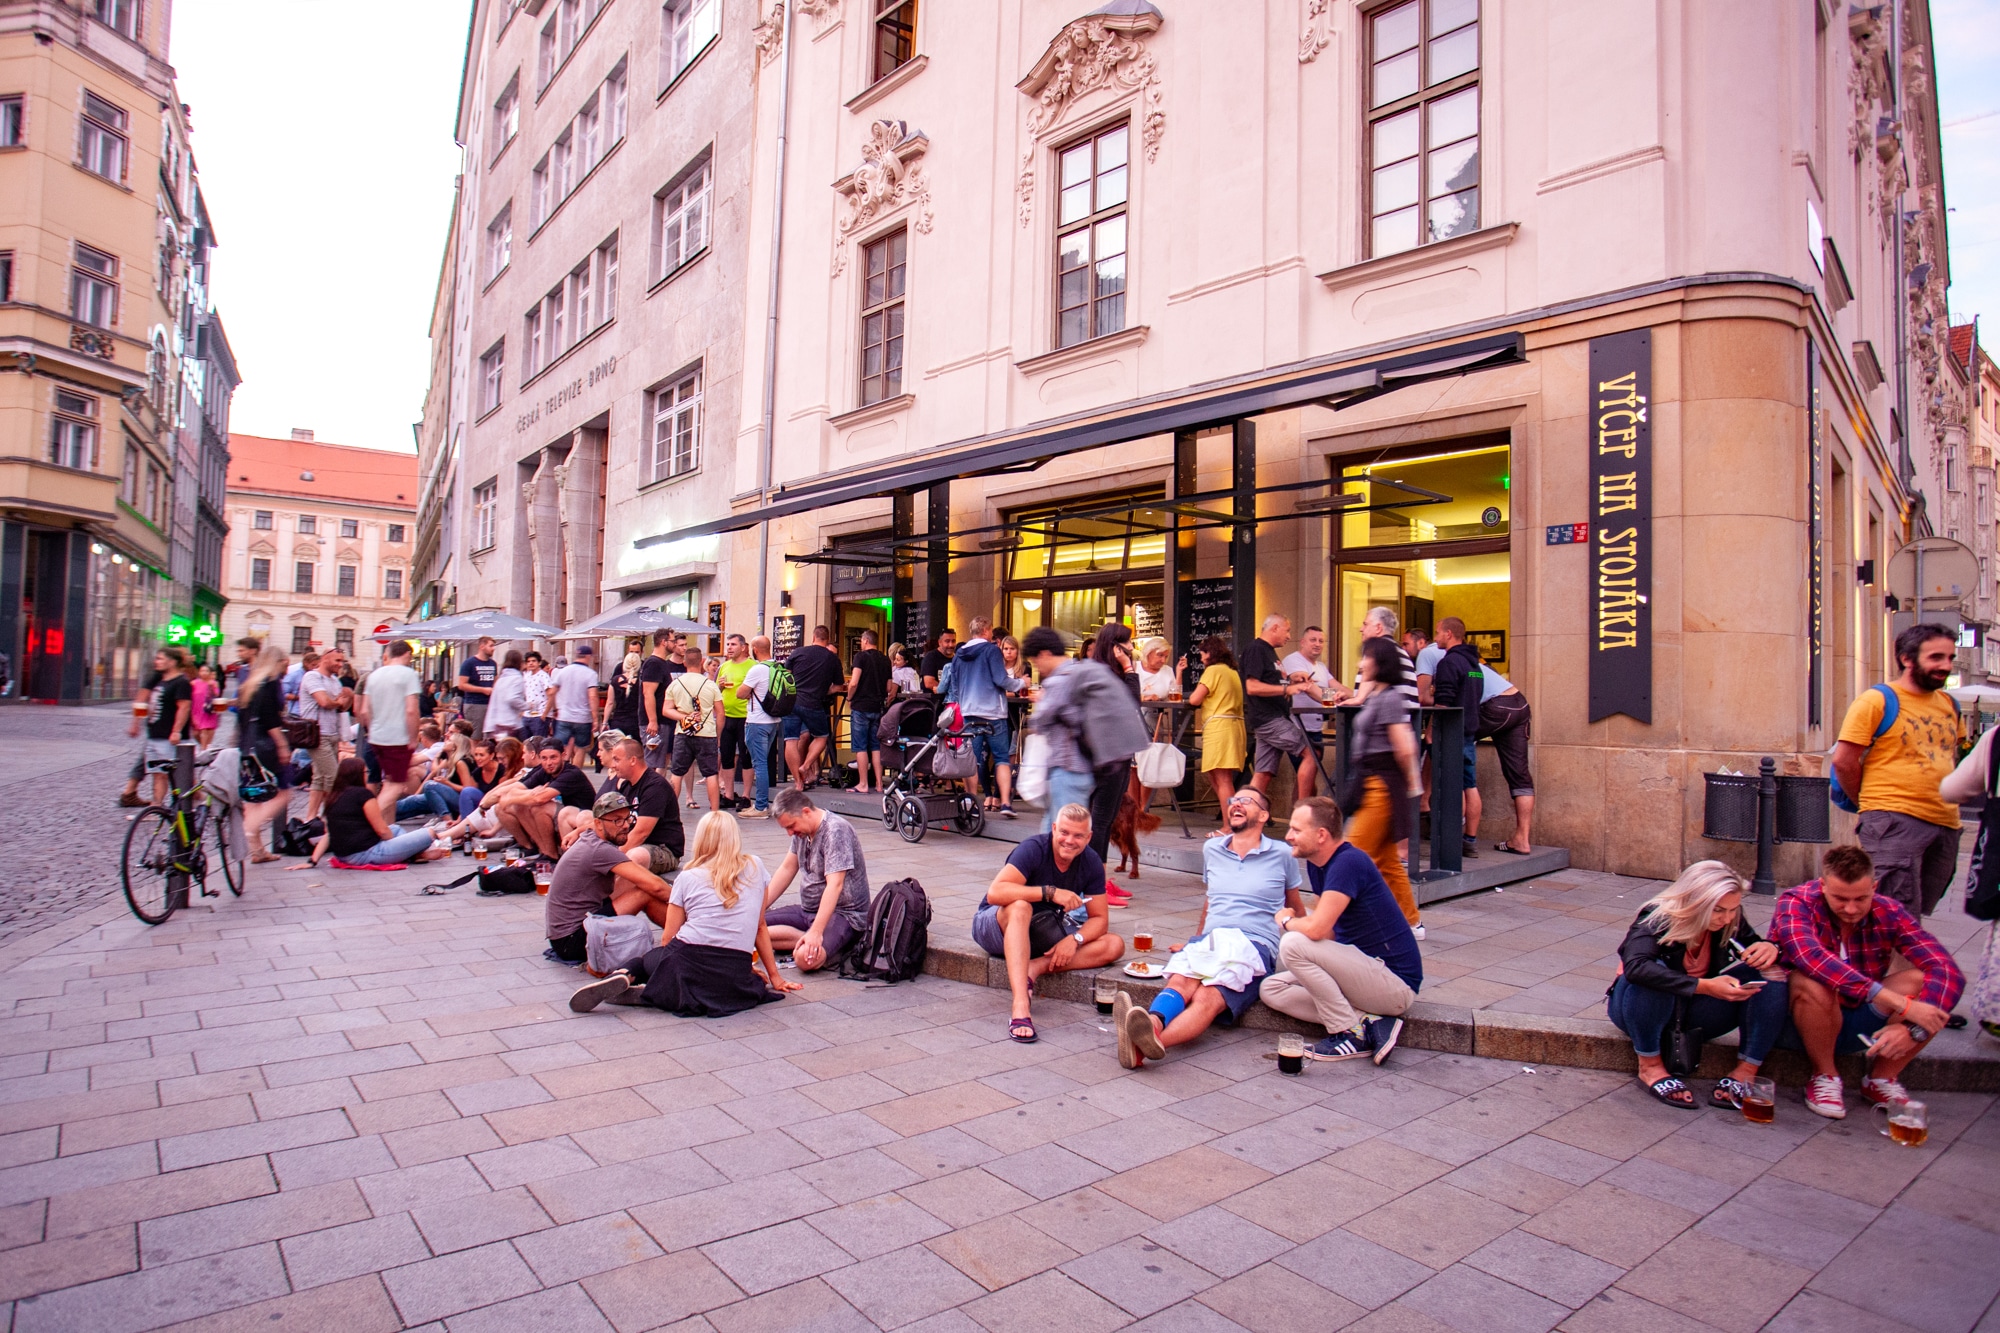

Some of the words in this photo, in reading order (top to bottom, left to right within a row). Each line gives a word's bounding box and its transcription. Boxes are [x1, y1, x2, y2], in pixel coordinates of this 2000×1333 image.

[516, 402, 540, 434] ČESKÁ
[545, 378, 582, 416] TELEVIZE
[589, 355, 617, 387] BRNO
[1598, 371, 1647, 459] VÝČEP
[1598, 471, 1637, 517] NA
[1598, 526, 1648, 652] STOJÁKA
